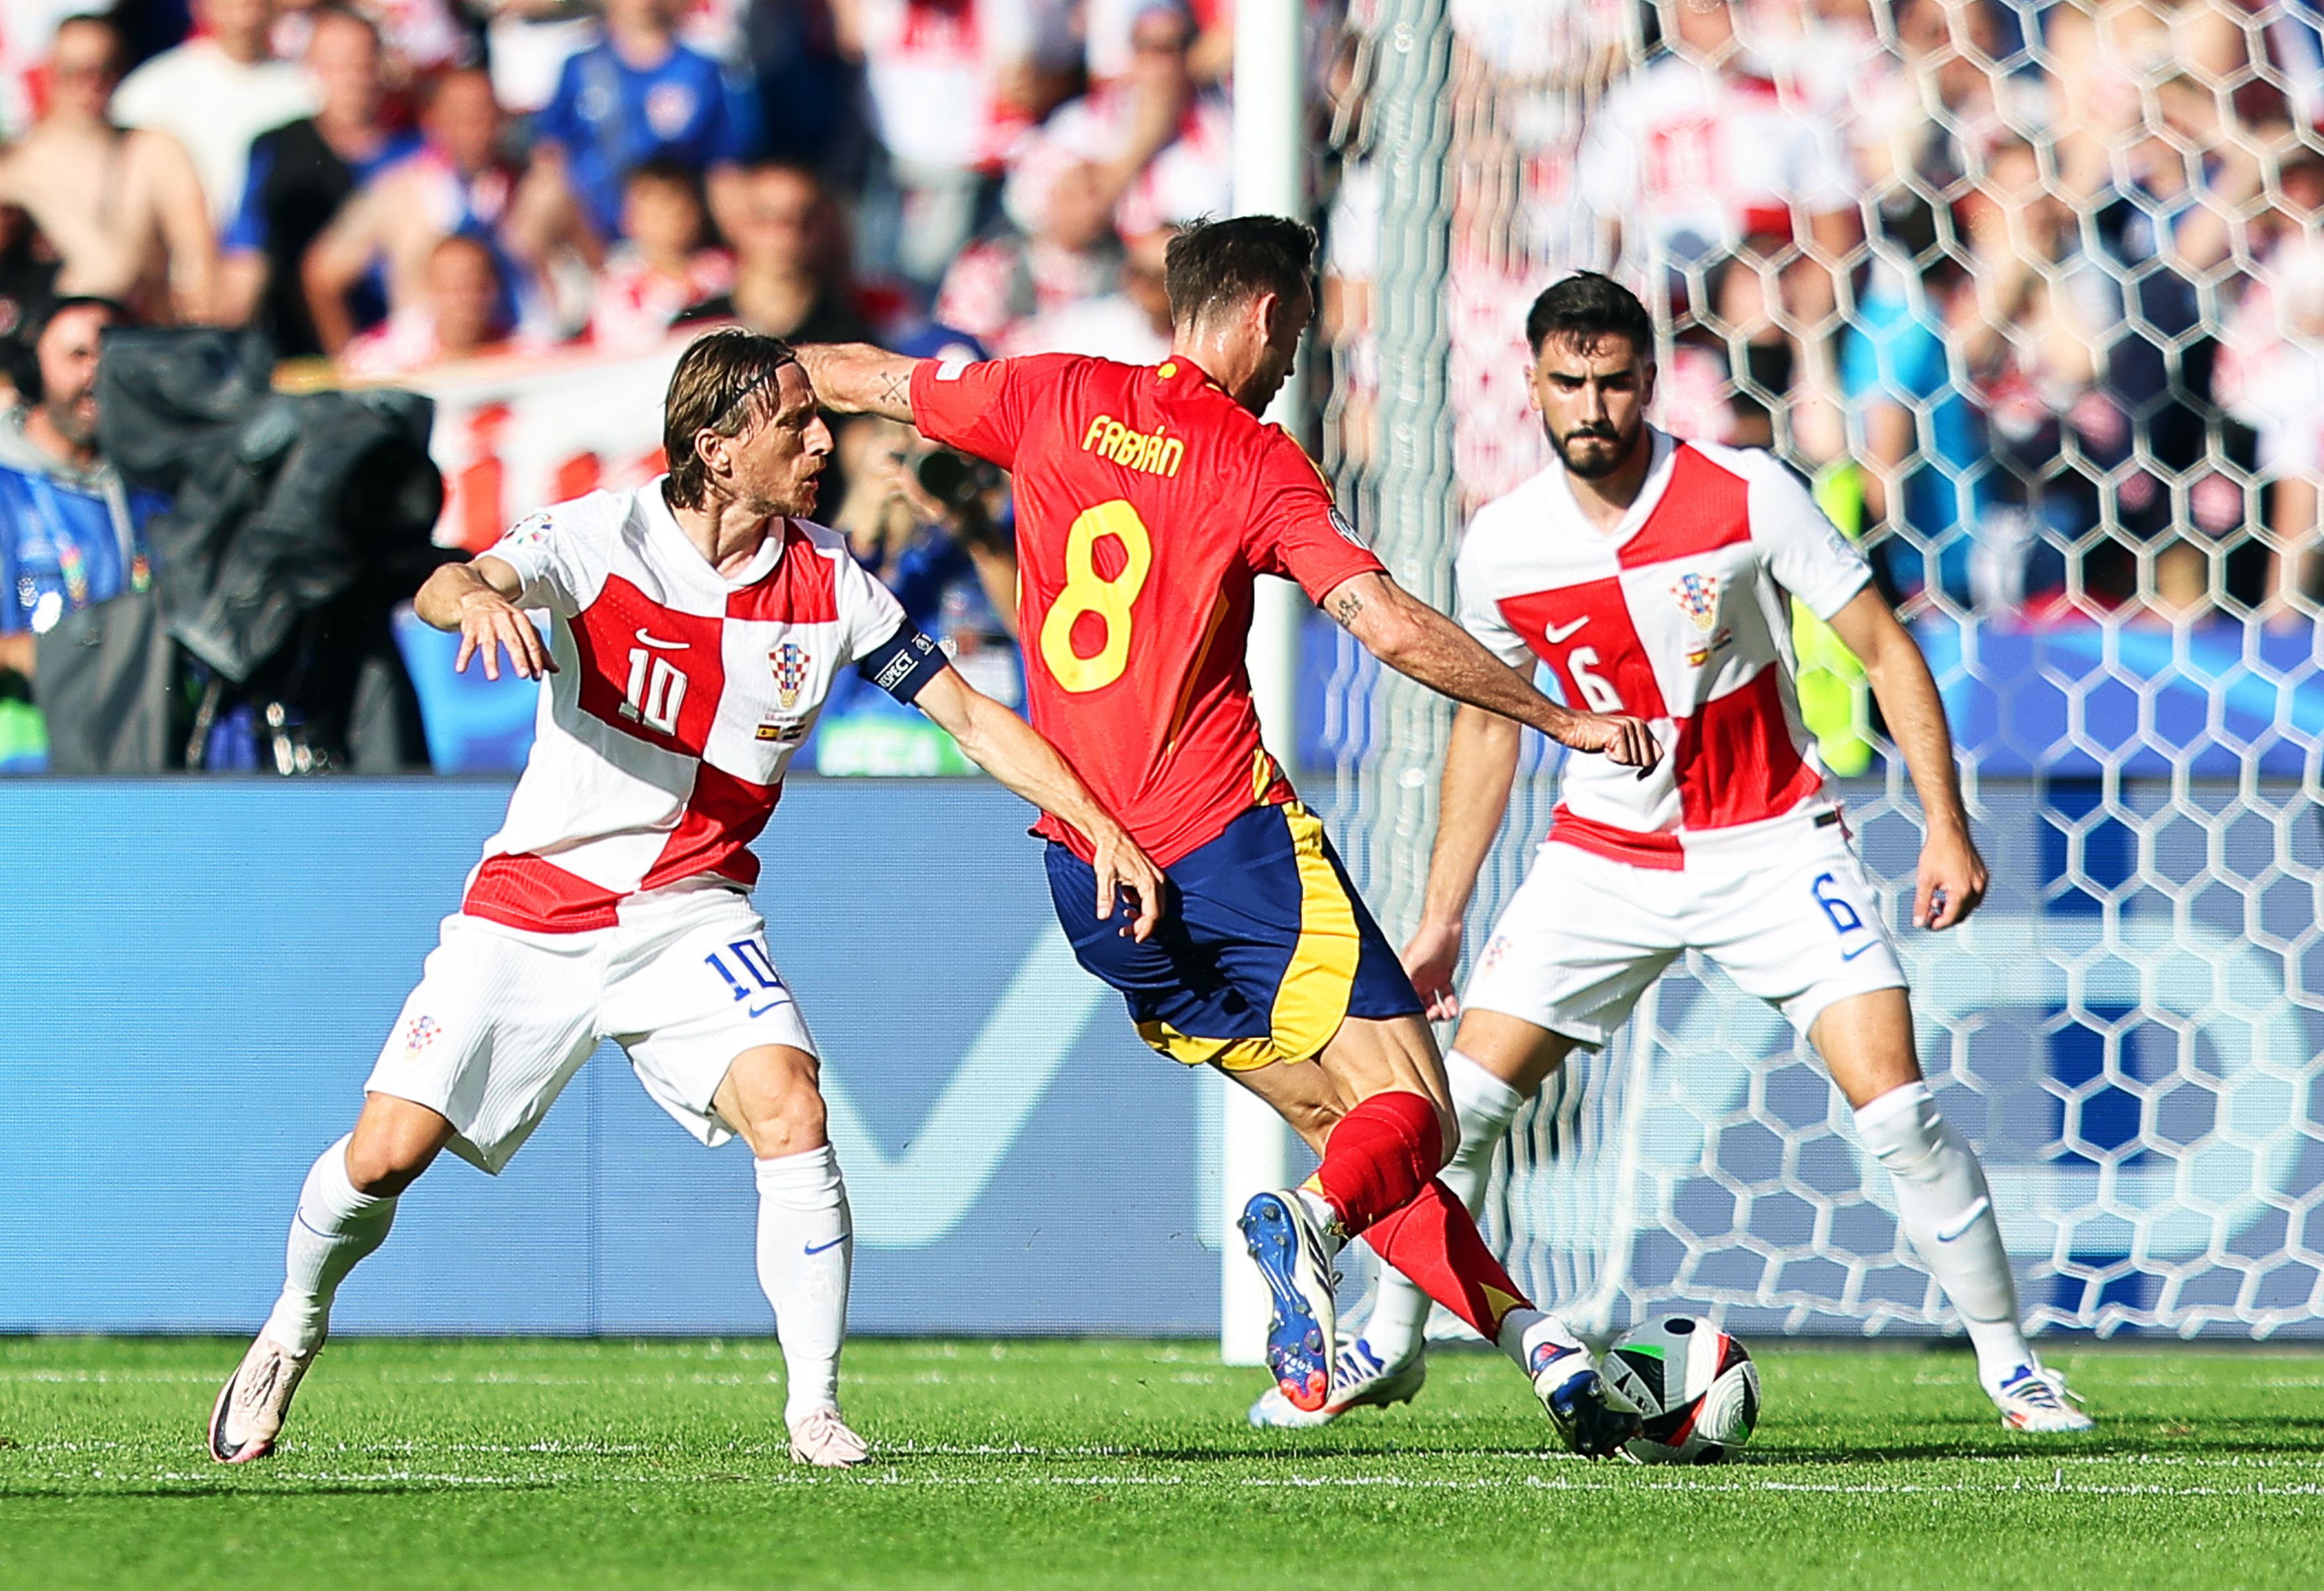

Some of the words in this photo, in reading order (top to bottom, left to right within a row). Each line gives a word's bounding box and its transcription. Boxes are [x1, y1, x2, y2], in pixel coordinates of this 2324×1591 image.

[1082, 414, 1185, 478] FABIÁN
[1039, 499, 1153, 693] 8
[618, 648, 688, 736] 10
[1568, 645, 1625, 713] 6
[1811, 872, 1863, 934] 6
[705, 940, 788, 1001] 10
